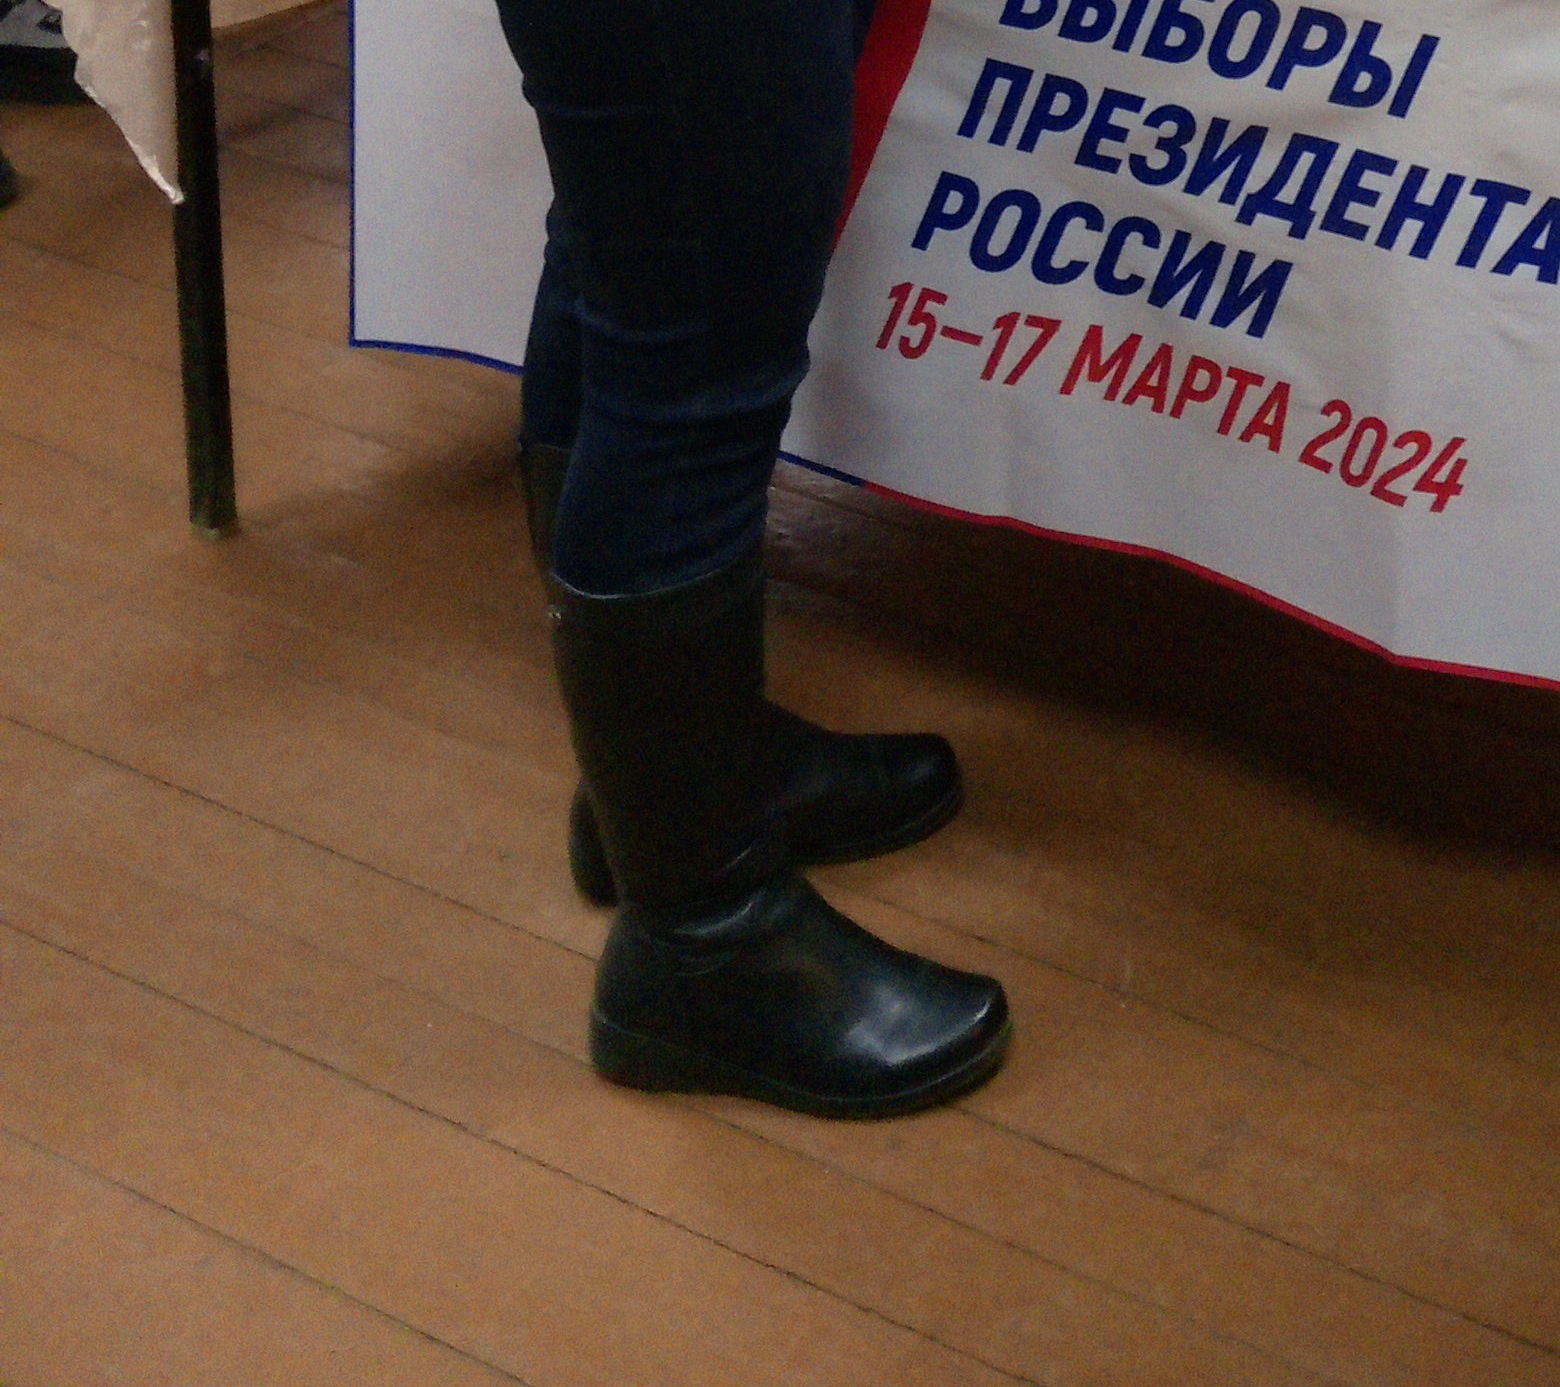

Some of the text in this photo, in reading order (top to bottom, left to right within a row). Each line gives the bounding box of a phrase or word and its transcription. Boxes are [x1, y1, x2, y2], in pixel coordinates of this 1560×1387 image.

[911, 171, 1295, 339] РОССИИ
[1058, 323, 1291, 455] МАРТА
[1297, 397, 1468, 514] 2024
